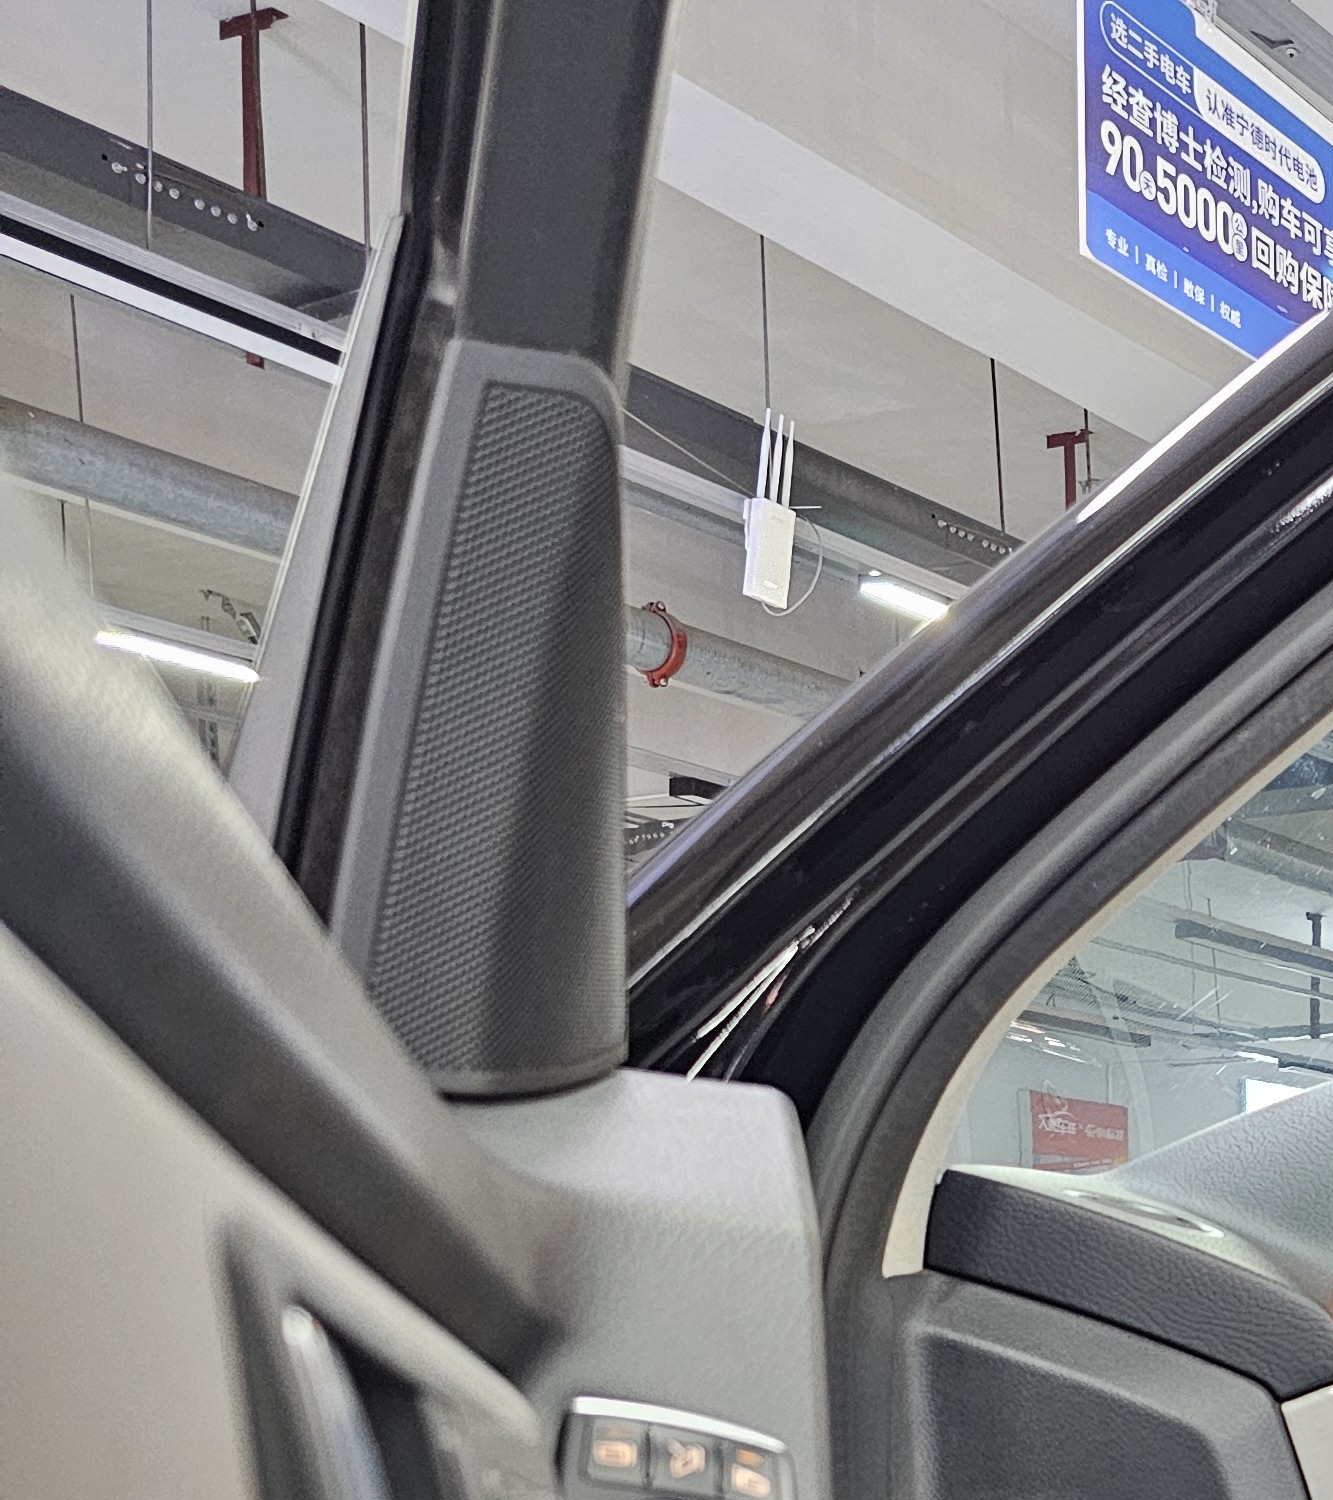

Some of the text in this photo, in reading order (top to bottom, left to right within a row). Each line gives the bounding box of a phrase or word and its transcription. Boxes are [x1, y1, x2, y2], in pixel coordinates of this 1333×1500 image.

[1109, 13, 1319, 193] 选二手电车 认准宁德时代电池
[1104, 229, 1130, 258] 专业
[1219, 301, 1243, 329] 权威
